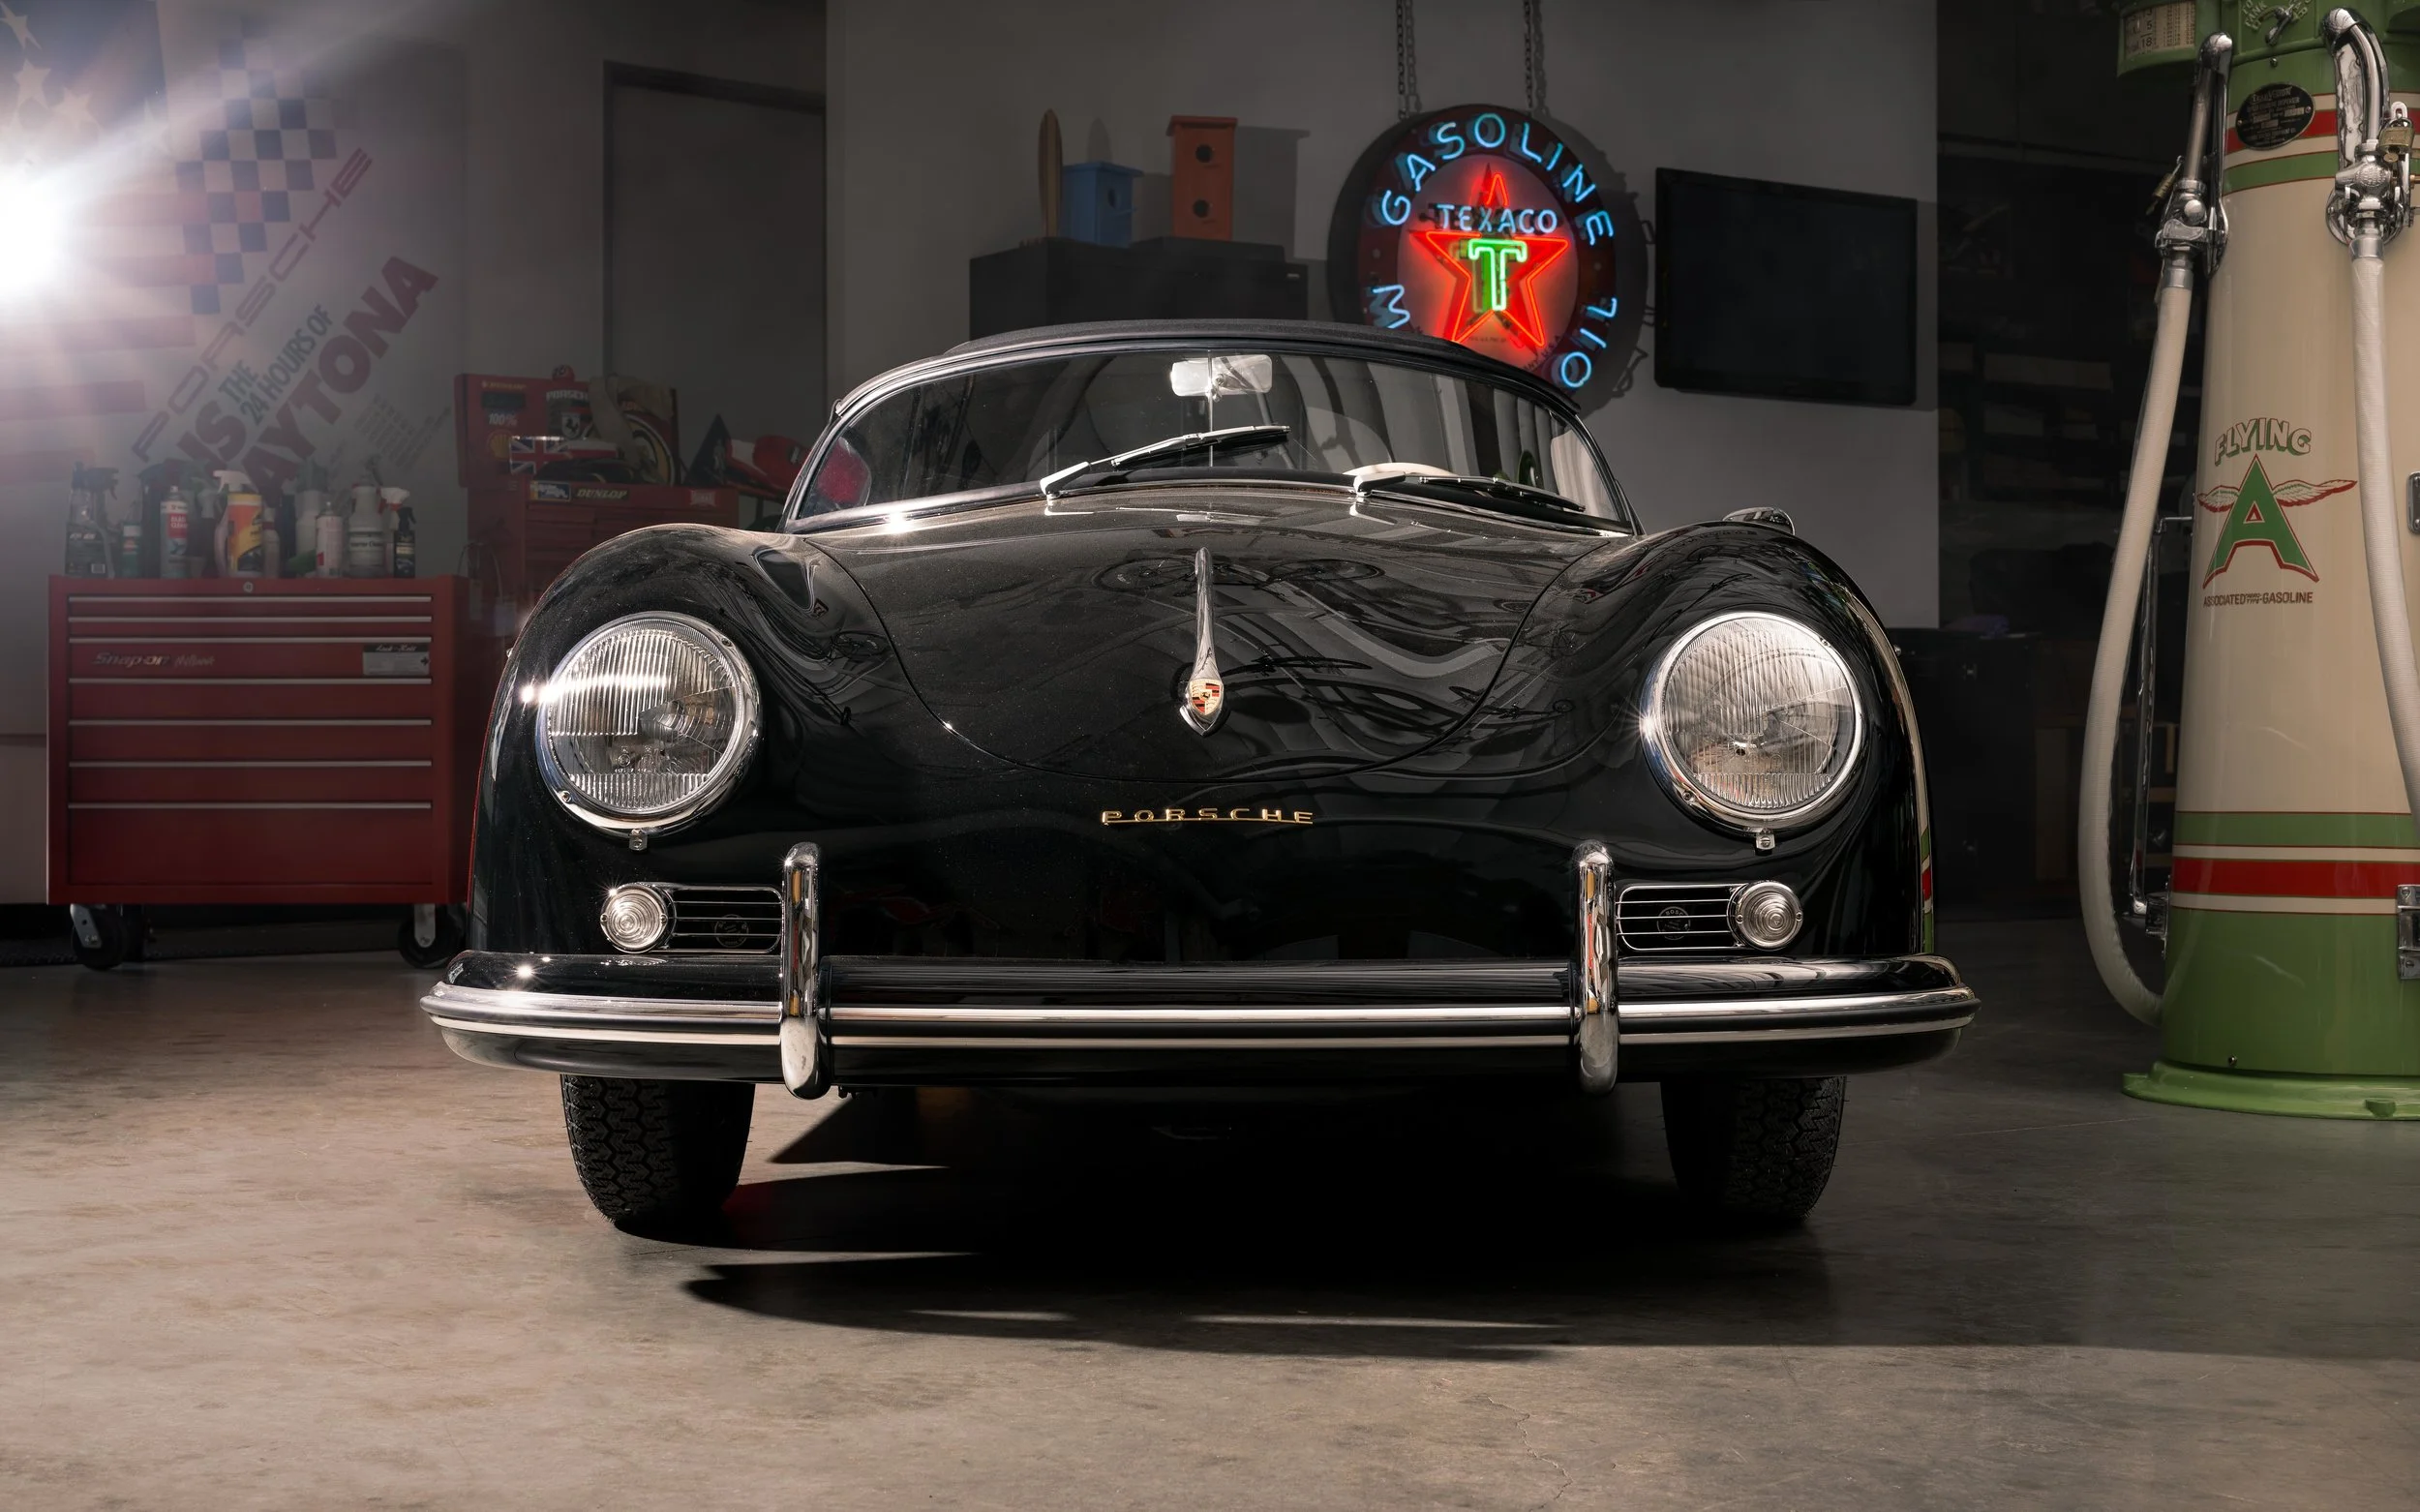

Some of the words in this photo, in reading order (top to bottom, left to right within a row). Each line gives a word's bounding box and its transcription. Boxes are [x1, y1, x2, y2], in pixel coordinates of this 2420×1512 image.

[1380, 112, 1615, 245] GASOLINE
[1437, 203, 1558, 234] TEXACO
[1467, 238, 1528, 312] T
[131, 147, 373, 463] PORSCHE
[240, 398, 271, 427] 24
[258, 327, 318, 402] HOURS
[307, 304, 334, 338] OF
[1560, 296, 1618, 388] OIL
[218, 359, 260, 406] THE
[240, 256, 439, 509] AYTONA
[545, 389, 589, 403] PORSCH
[488, 412, 519, 427] 100%
[2214, 417, 2313, 467] FLYING
[576, 487, 628, 499] DUNLOP
[2202, 453, 2320, 589] A
[2202, 593, 2246, 608] ASSOCIATED
[2262, 591, 2314, 605] GASOLINE
[92, 651, 170, 668] Snap-on
[1101, 807, 1314, 825] PORSCHE
